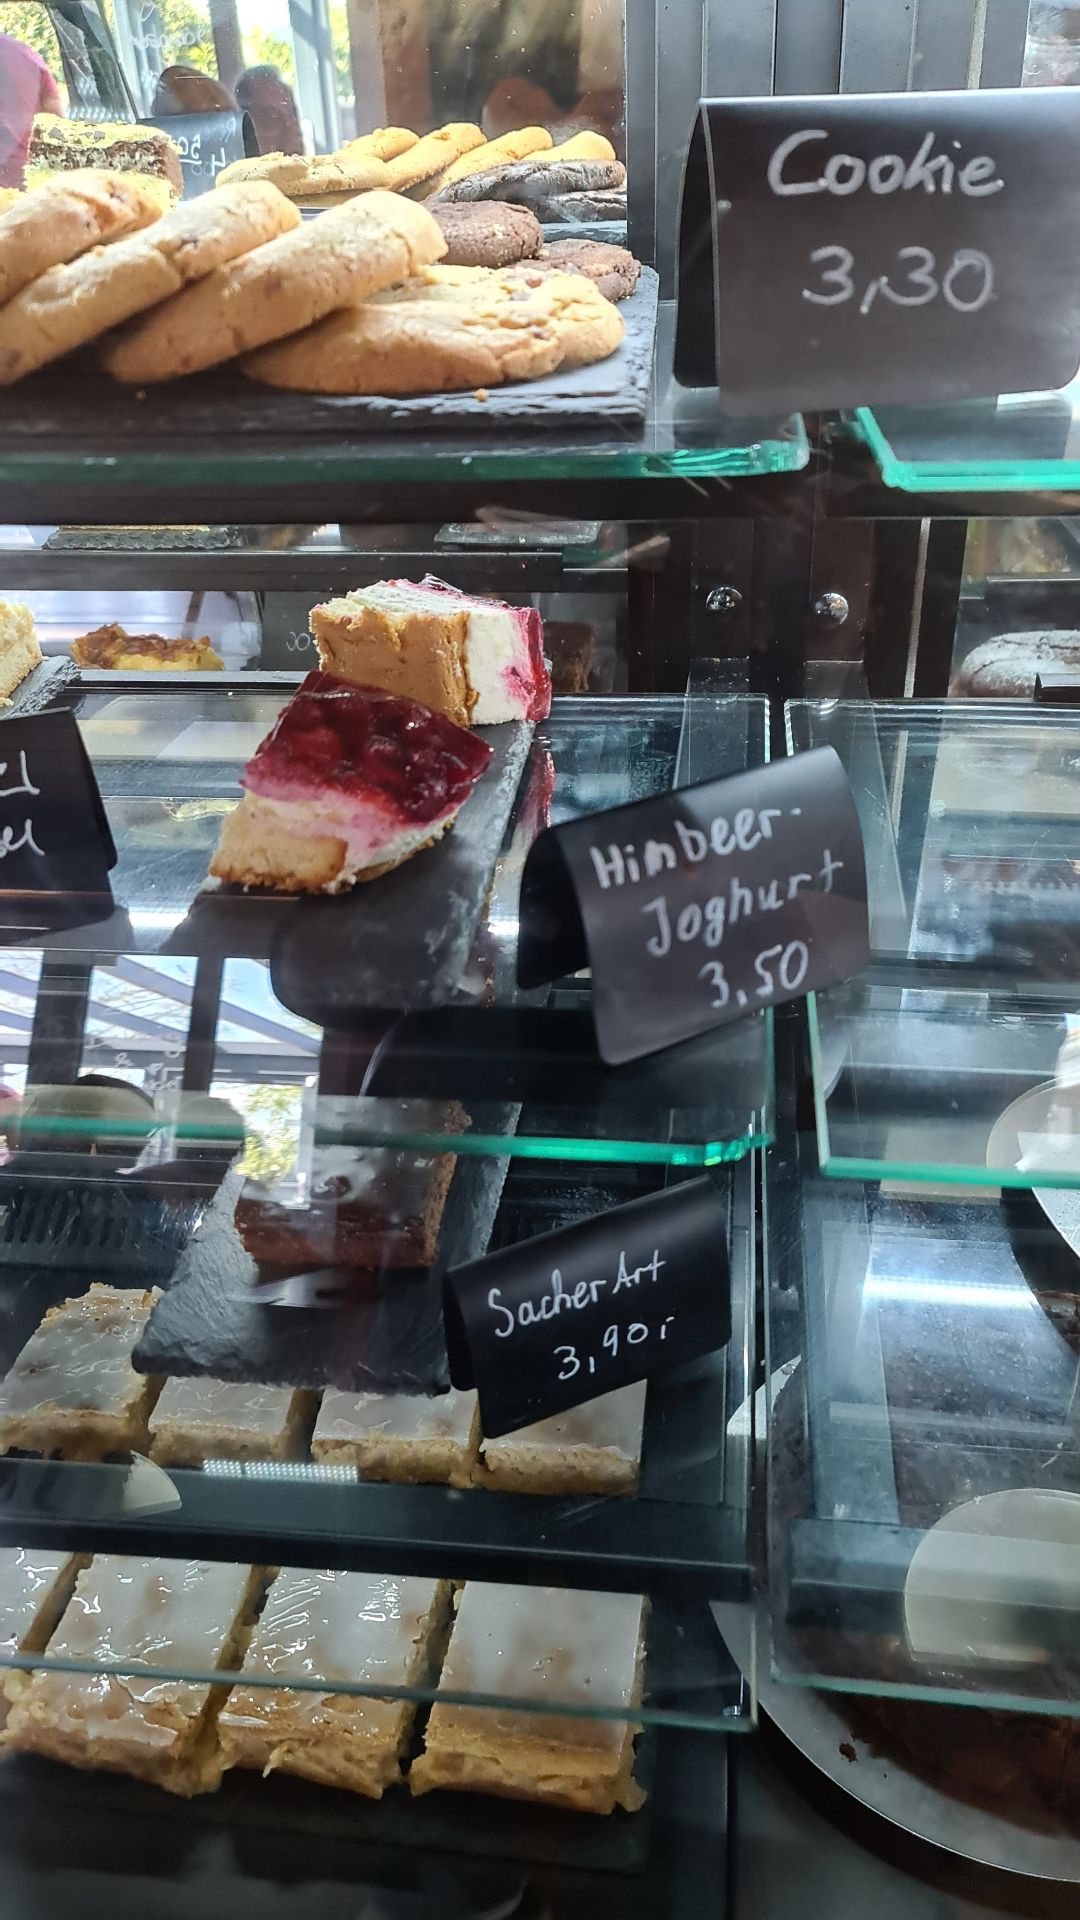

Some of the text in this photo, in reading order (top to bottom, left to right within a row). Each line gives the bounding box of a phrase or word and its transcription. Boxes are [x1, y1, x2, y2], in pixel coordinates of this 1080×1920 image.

[767, 129, 1005, 197] Cookie
[802, 245, 995, 314] 3,30
[640, 850, 844, 957] Joghurt
[699, 940, 809, 1008] 3,50
[487, 1249, 667, 1338] Sacher Art
